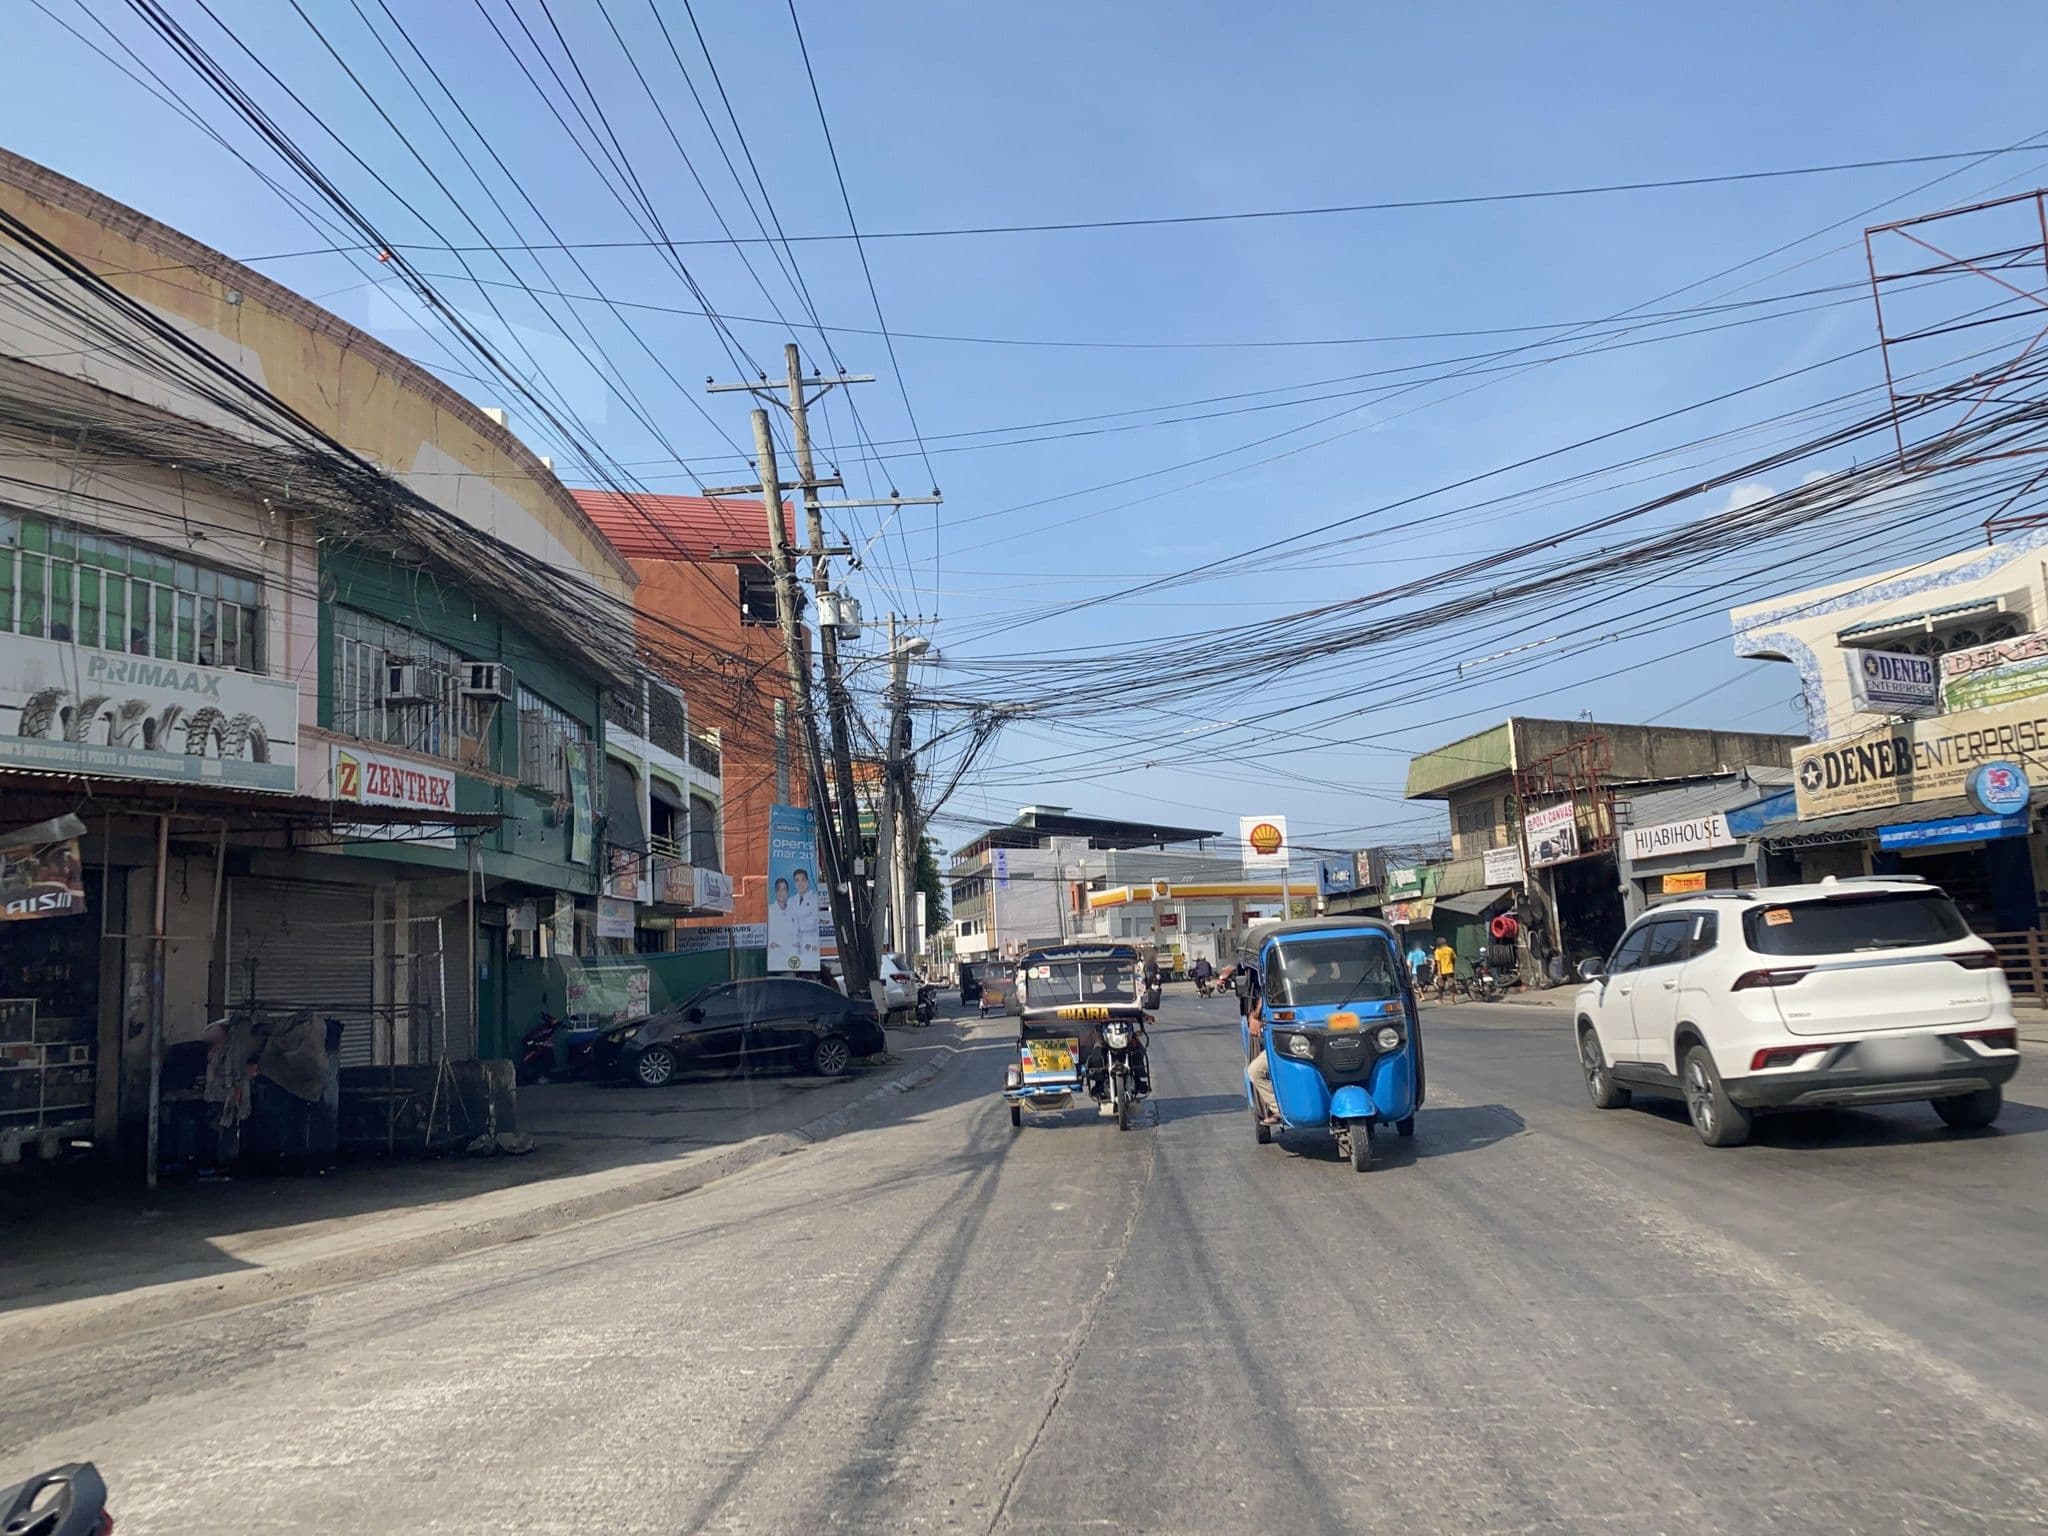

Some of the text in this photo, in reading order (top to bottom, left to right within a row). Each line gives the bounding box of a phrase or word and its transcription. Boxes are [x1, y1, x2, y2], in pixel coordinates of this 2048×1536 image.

[87, 655, 223, 697] PRIMAAX
[1879, 656, 1932, 684] DENEB
[1865, 679, 1935, 695] ENTERPRISES
[1823, 736, 1914, 789] DENEB
[341, 762, 451, 808] Z ZENTREX
[1548, 804, 1573, 823] CANVAS
[1635, 819, 1721, 852] HIJABIHOUSE
[698, 927, 723, 935] CLINIC
